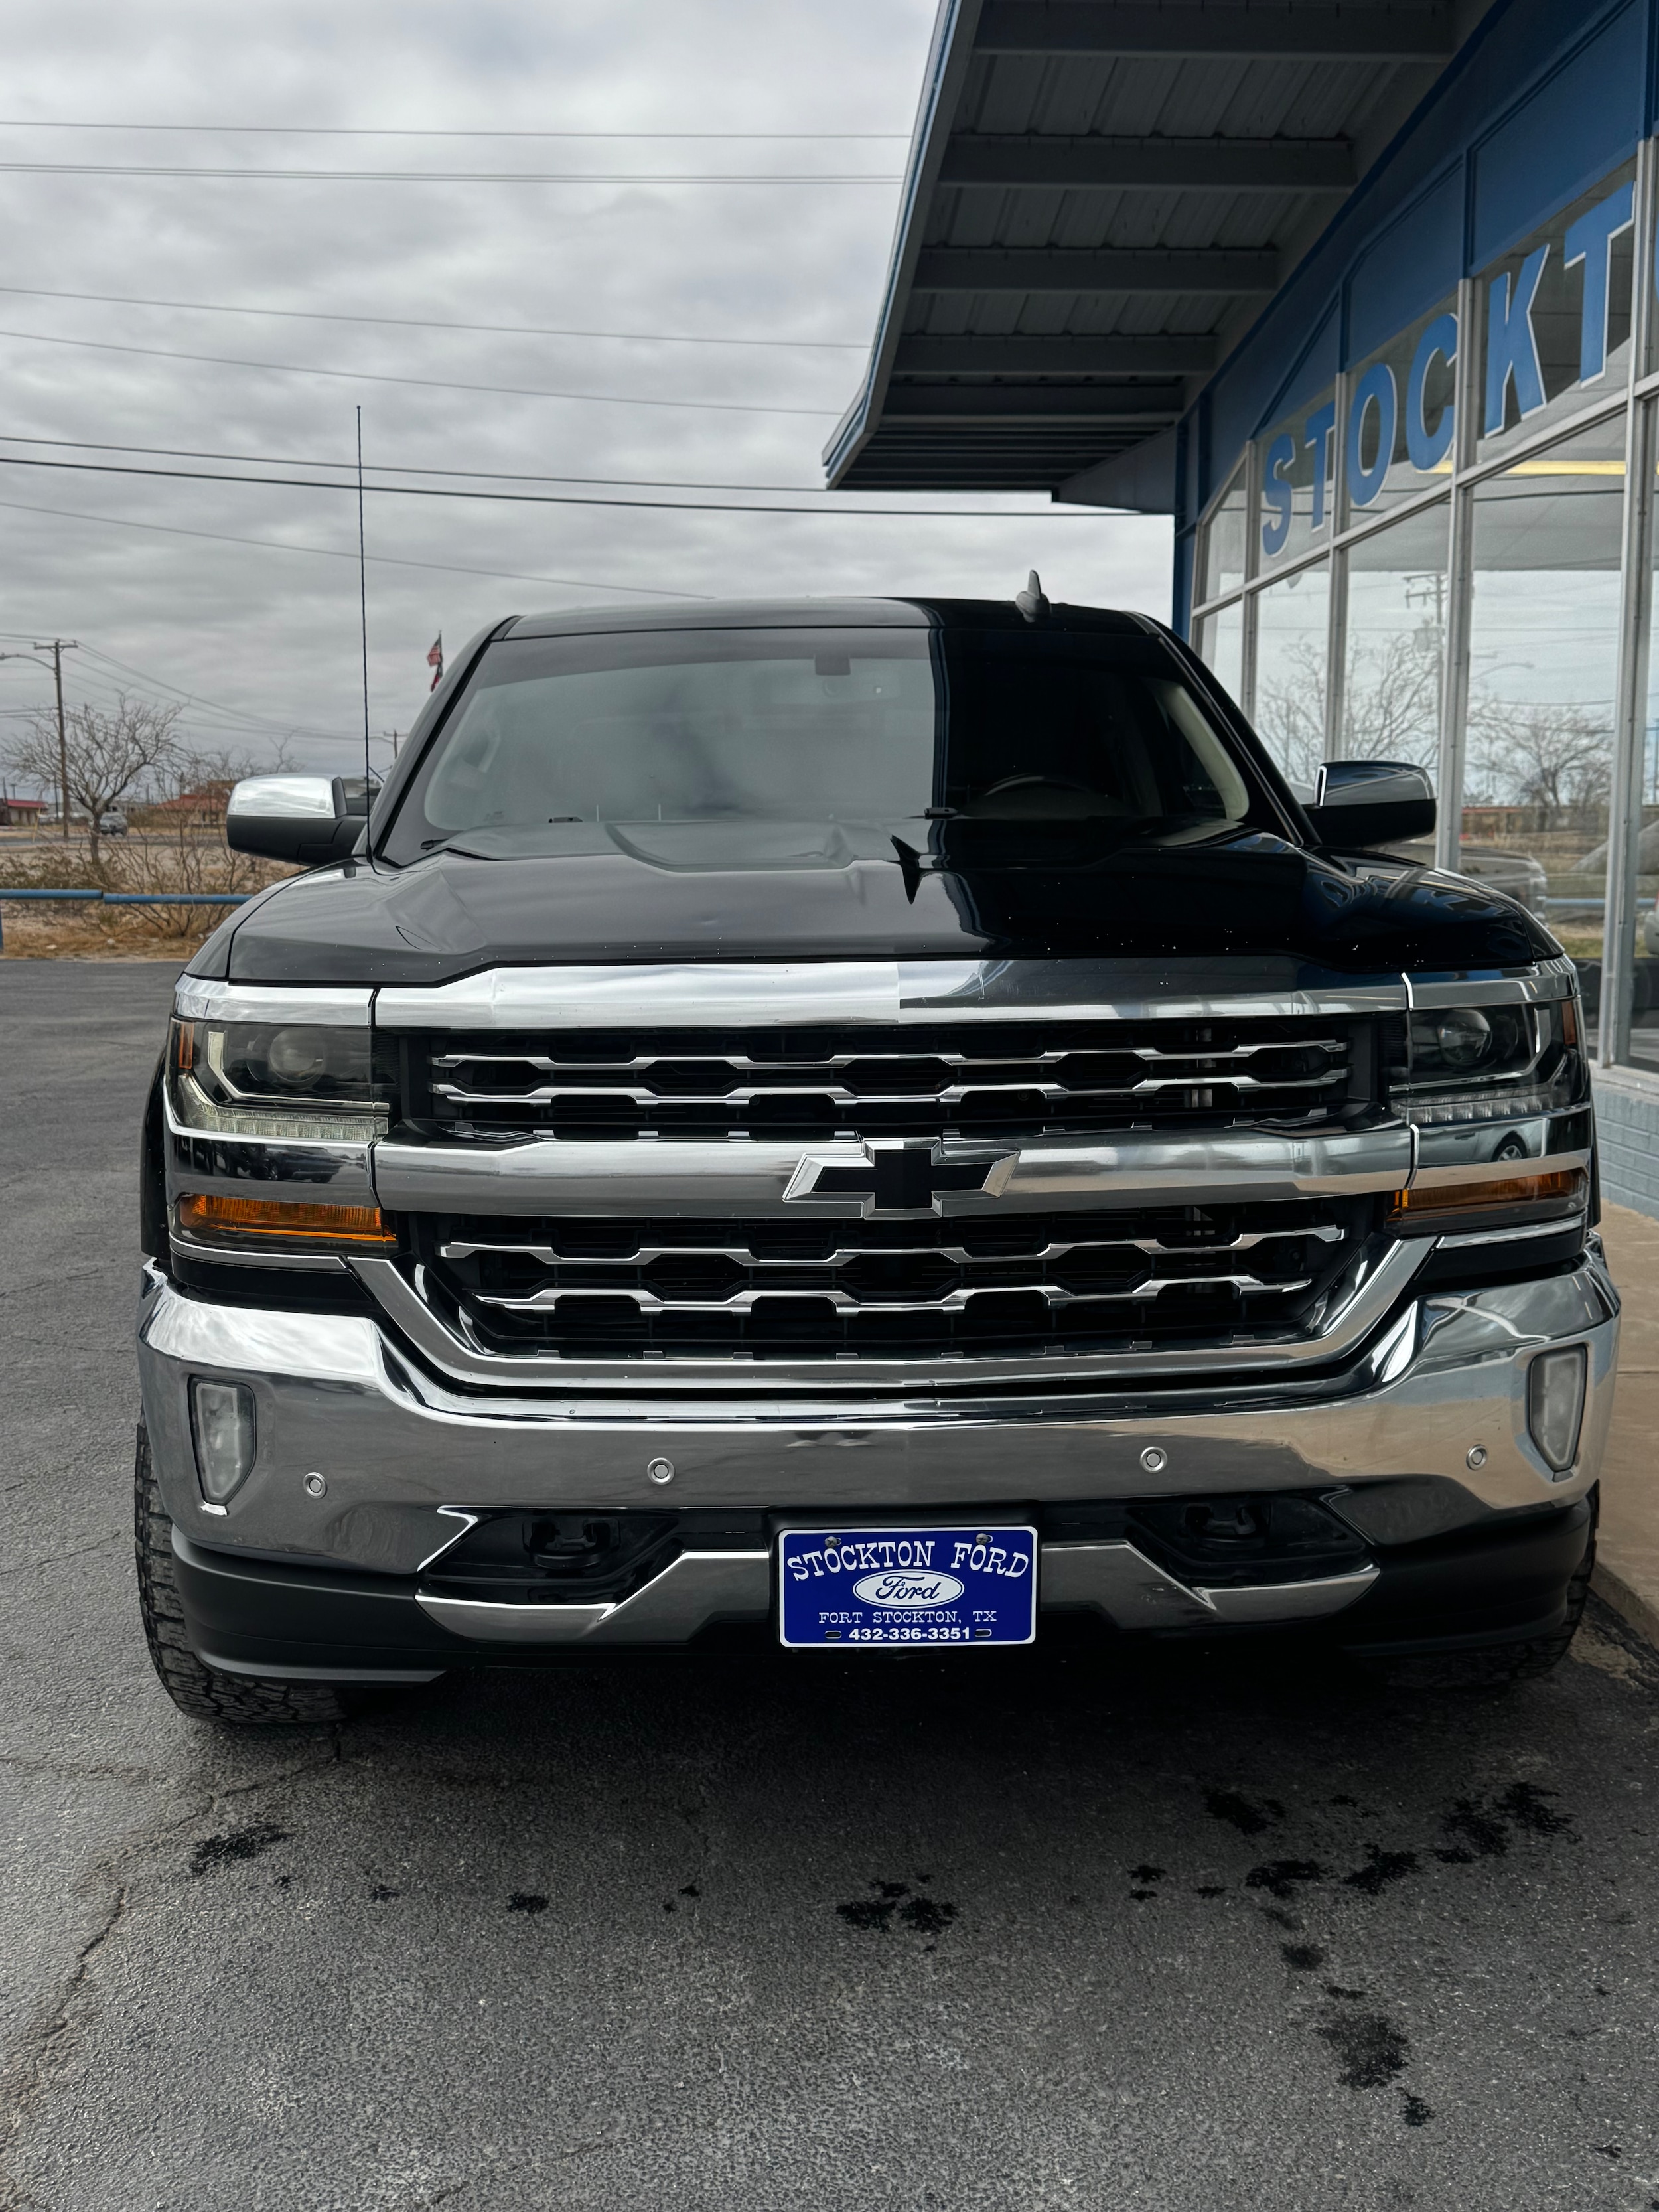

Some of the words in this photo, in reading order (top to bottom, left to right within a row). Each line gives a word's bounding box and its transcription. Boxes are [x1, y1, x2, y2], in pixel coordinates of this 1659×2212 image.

[1262, 181, 1659, 557] STOCKT
[787, 1540, 935, 1580] STOCKTON
[950, 1542, 1029, 1578] FORD
[875, 1575, 942, 1600] Ford
[819, 1612, 863, 1624] FORT
[873, 1611, 962, 1624] STOCKTON,
[973, 1610, 997, 1622] TX
[849, 1627, 970, 1641] 432-336-3351
